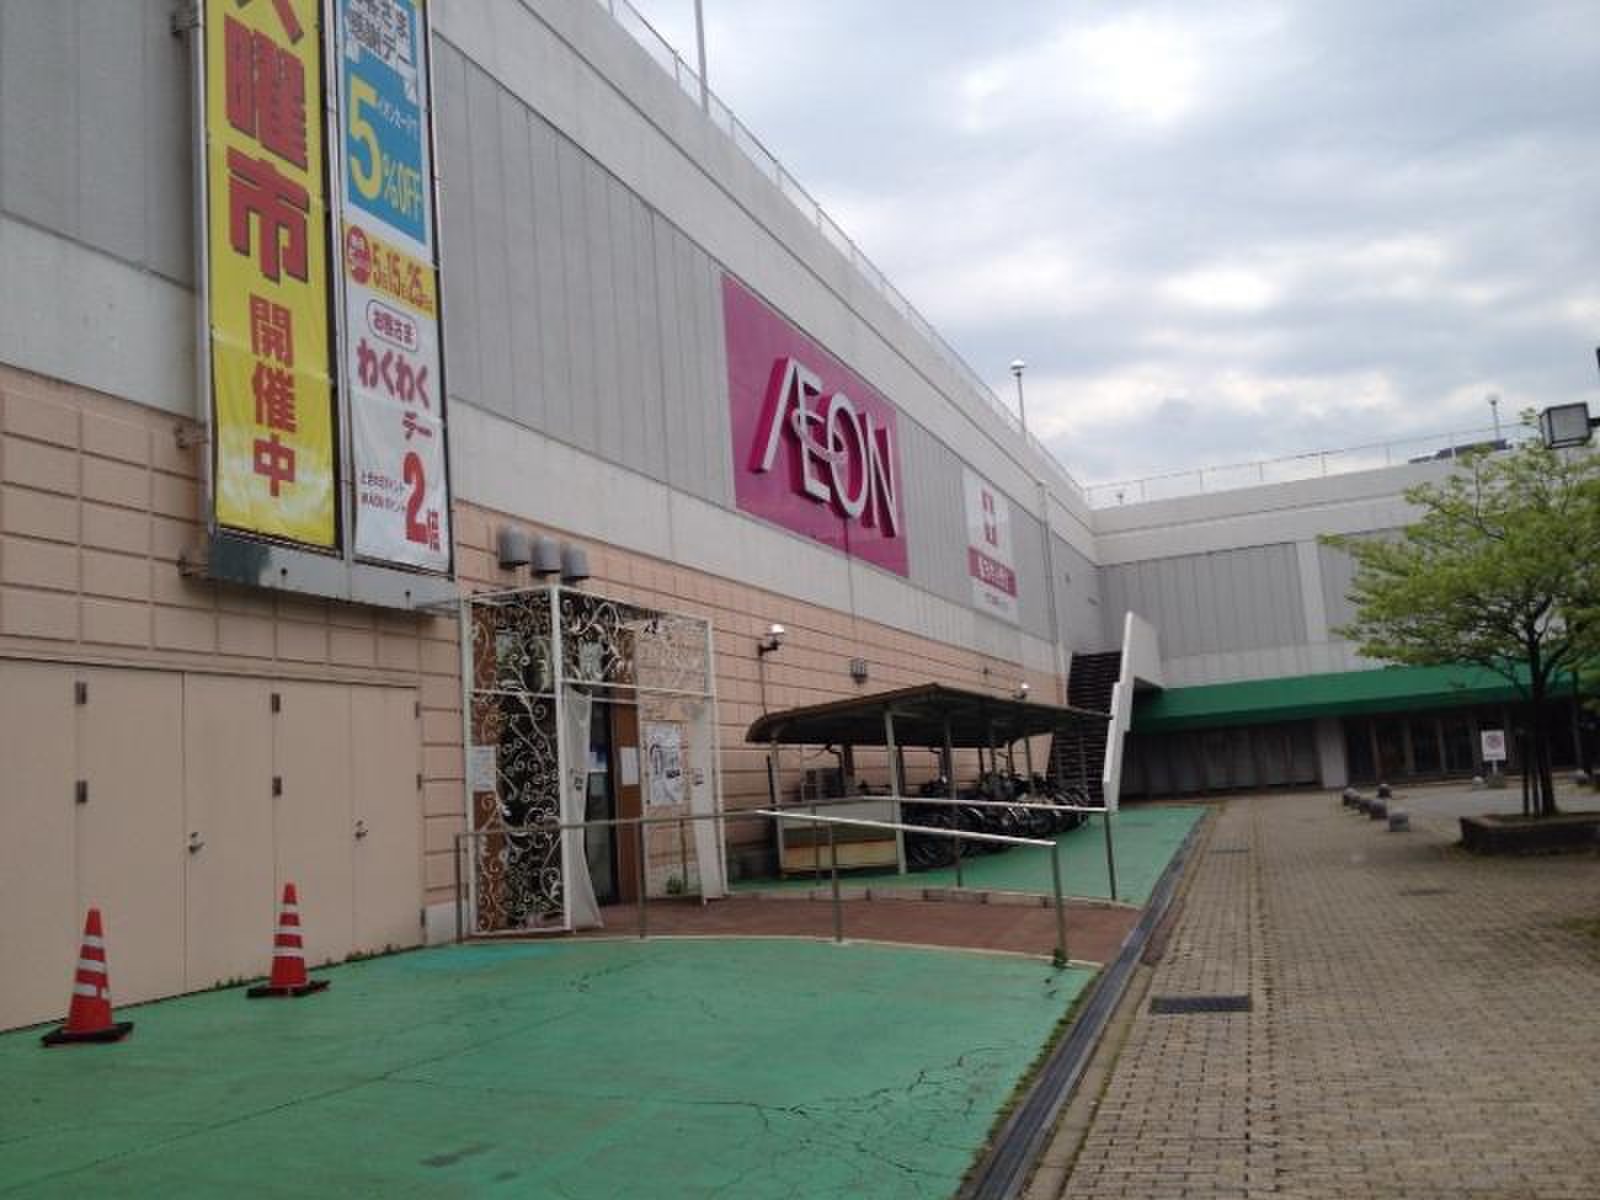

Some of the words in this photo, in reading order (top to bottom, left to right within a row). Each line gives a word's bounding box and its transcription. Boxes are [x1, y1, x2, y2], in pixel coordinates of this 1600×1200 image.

[248, 294, 297, 499] 開催中
[357, 338, 430, 410] わくわく
